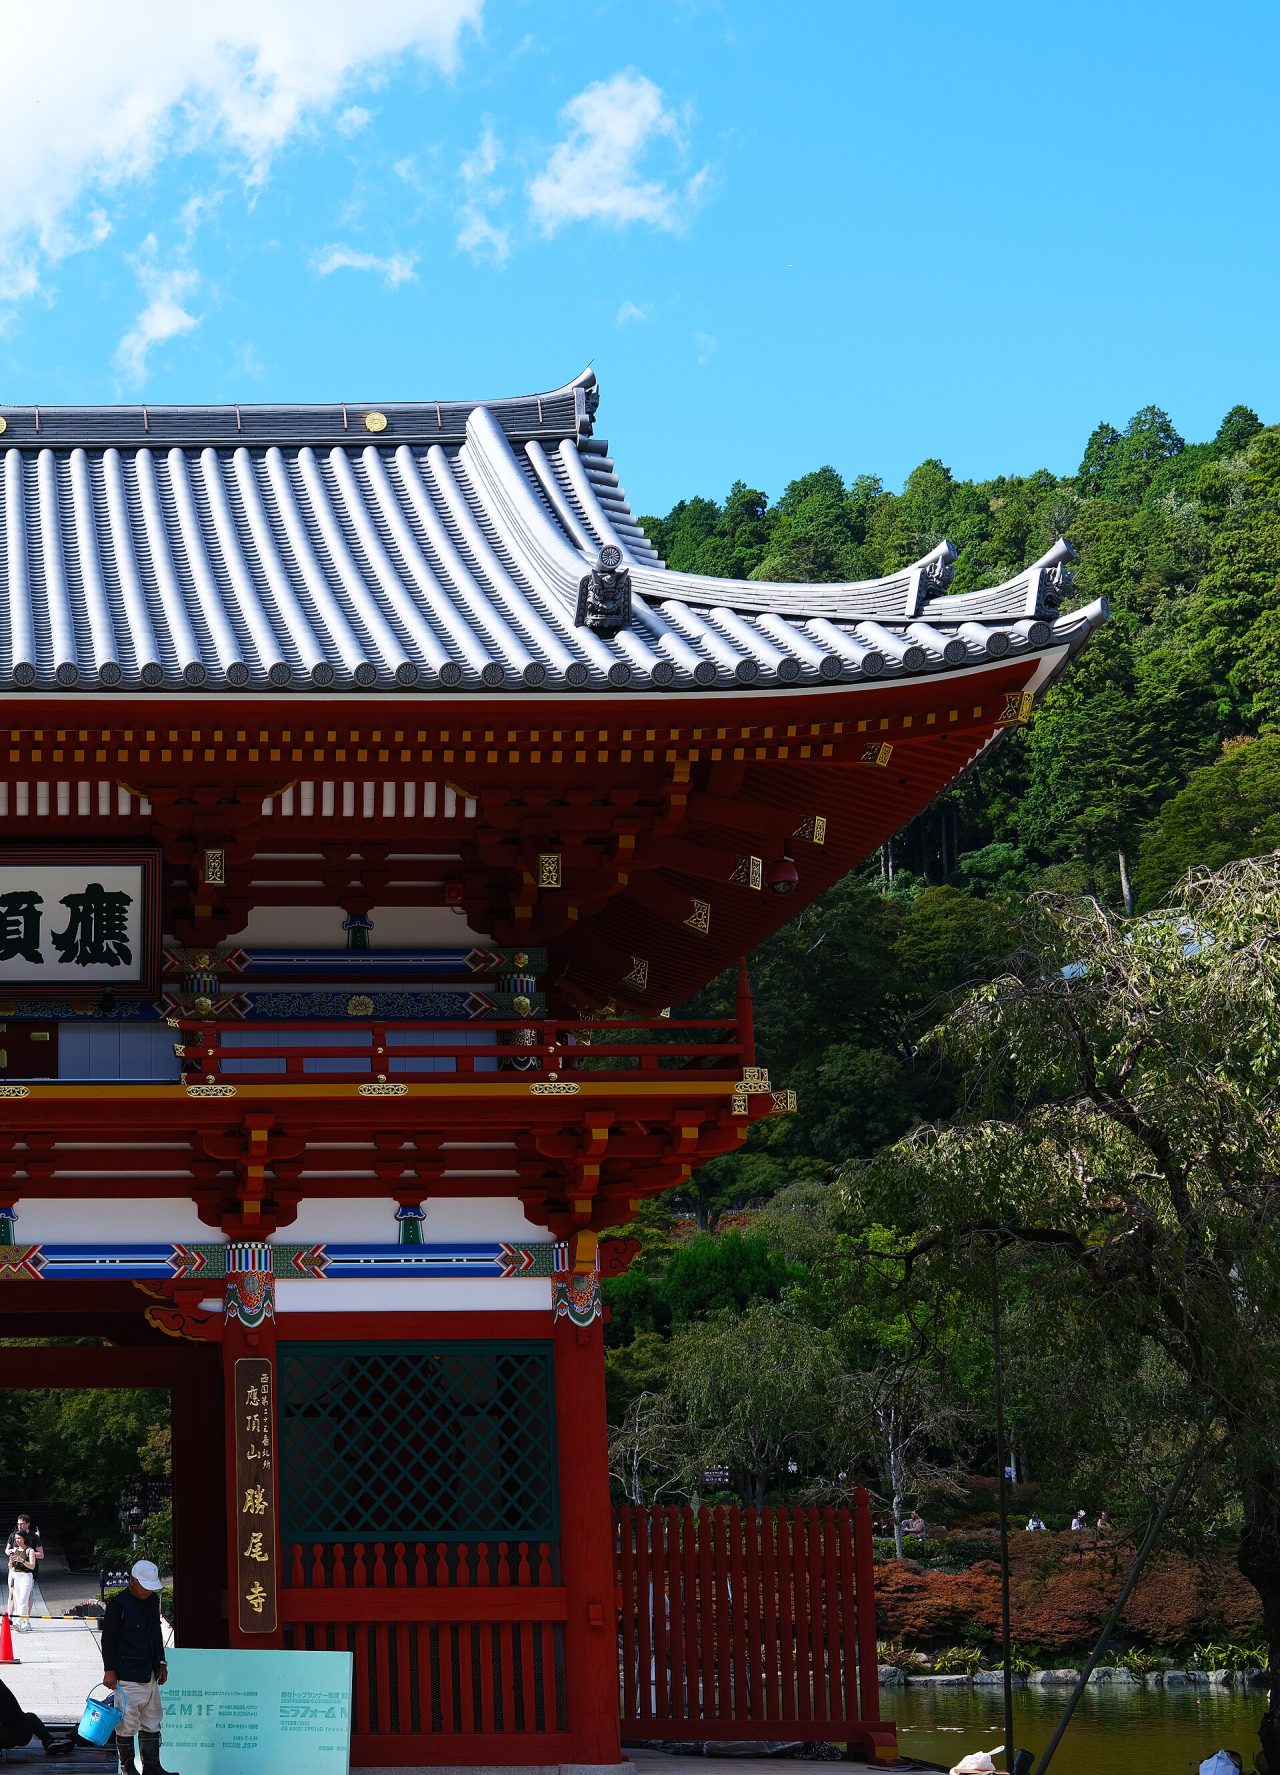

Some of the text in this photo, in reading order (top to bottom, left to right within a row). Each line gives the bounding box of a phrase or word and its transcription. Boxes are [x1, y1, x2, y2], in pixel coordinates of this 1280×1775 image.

[242, 1386, 269, 1614] 應頂山 勝尾寺
